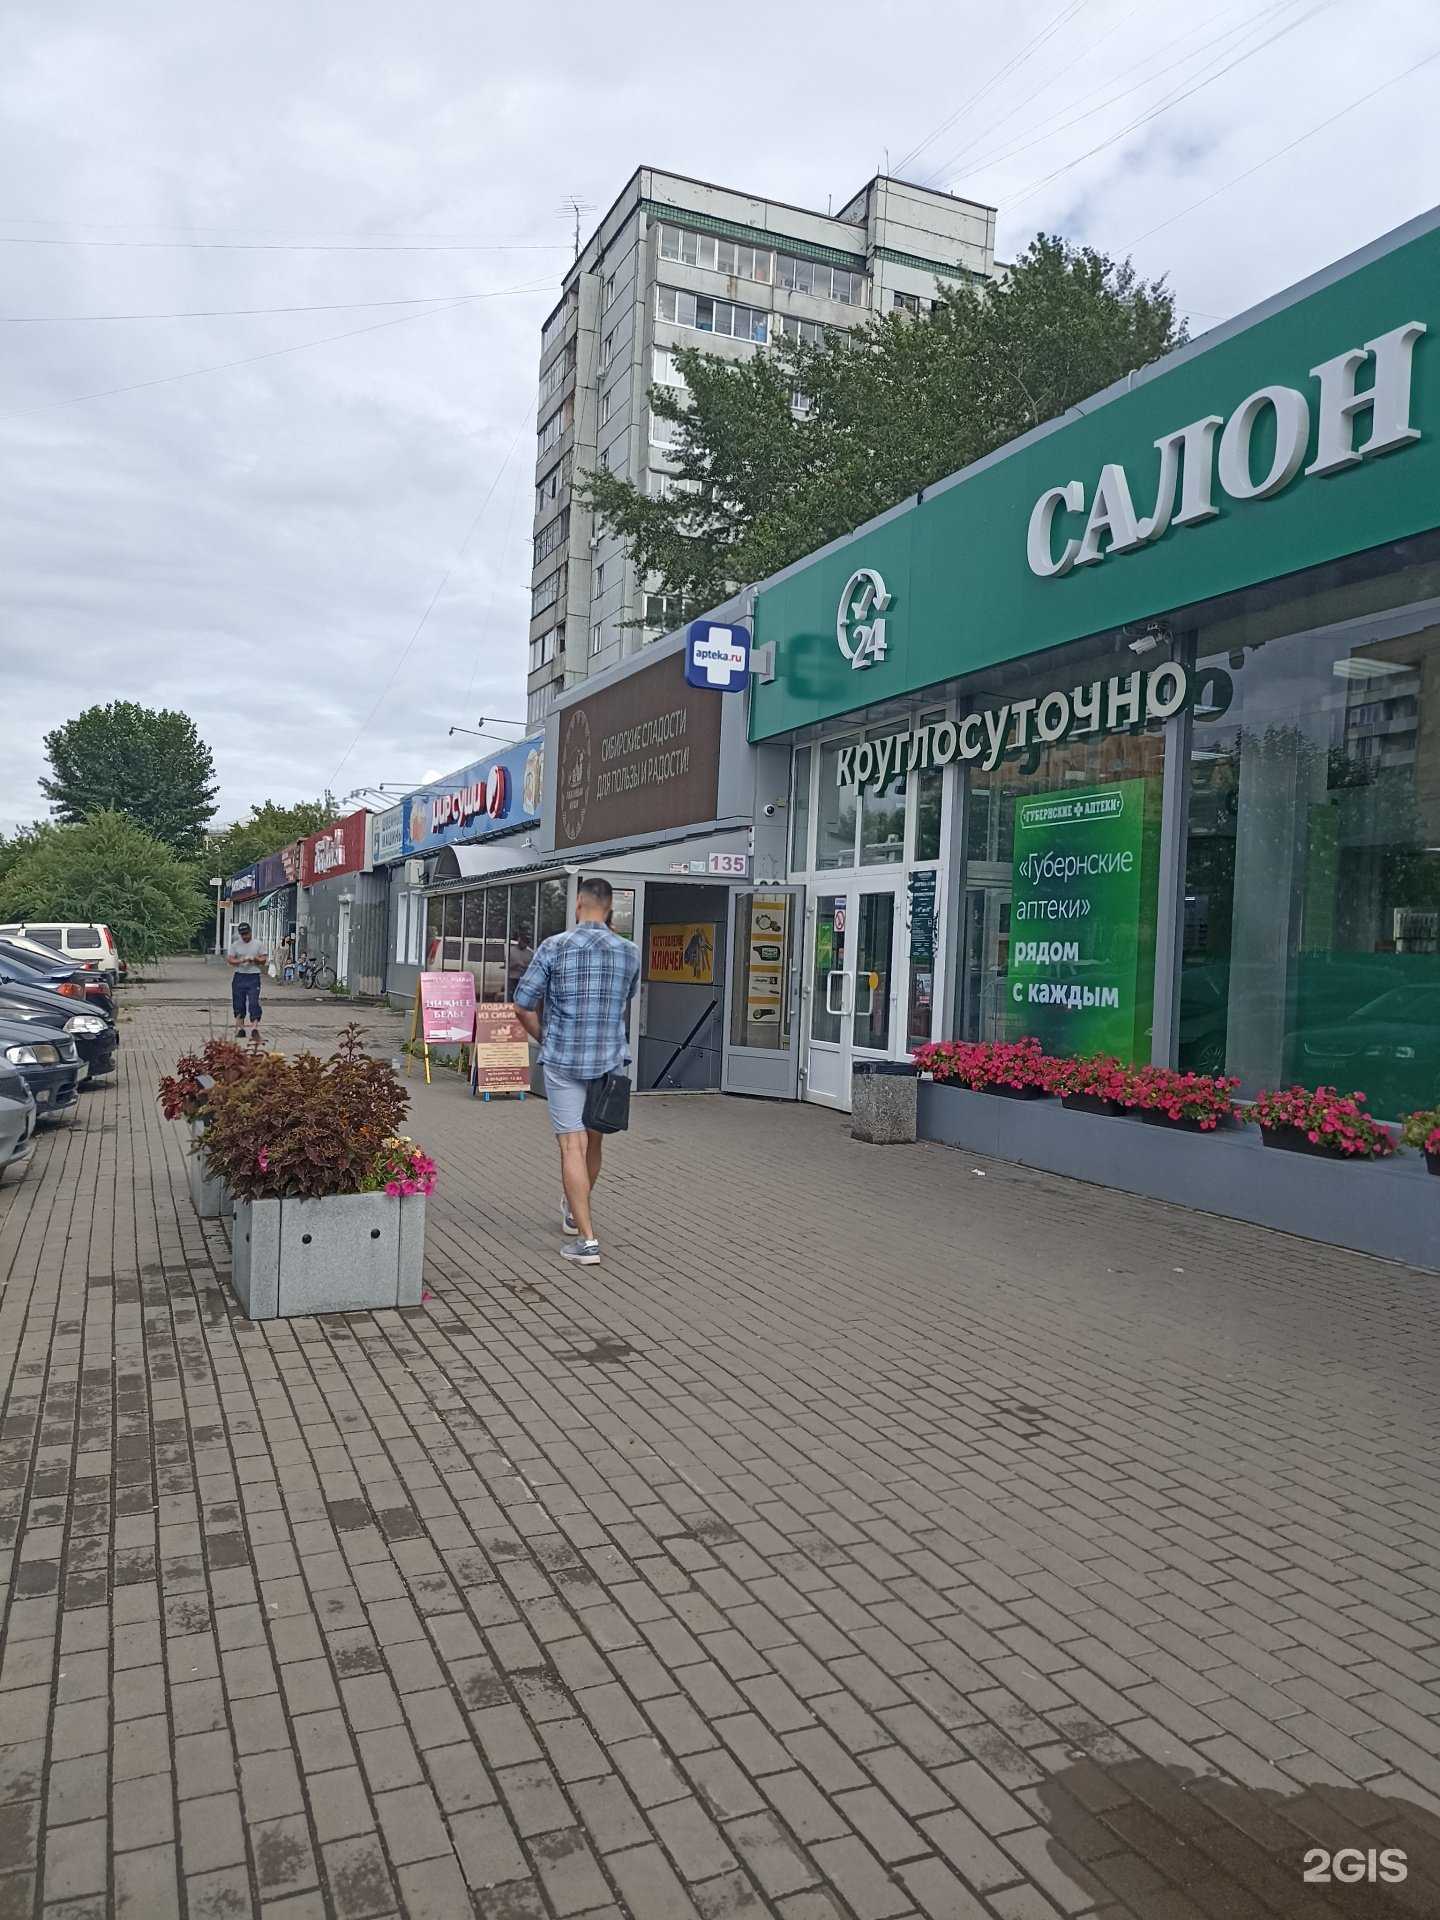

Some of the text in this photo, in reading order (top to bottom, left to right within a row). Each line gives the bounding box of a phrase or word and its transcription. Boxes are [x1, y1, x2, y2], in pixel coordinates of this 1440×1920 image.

[1027, 320, 1427, 577] САЛОН
[695, 648, 742, 663] apteka.ru
[851, 618, 888, 670] 24
[601, 707, 687, 762] СИБИРСКИЕ СЛАДОСТИ
[836, 661, 1187, 795] круглосуточно
[596, 773, 611, 801] ДЛЯ
[611, 764, 640, 793] ПОЛЬЗЫ
[710, 855, 744, 872] 135
[1018, 851, 1133, 885] «Губернские
[1016, 900, 1090, 920] аптеки»
[651, 948, 684, 971] КЛЮЧЕЙ
[1014, 941, 1079, 967] рядом
[1012, 983, 1119, 1010] с каждым
